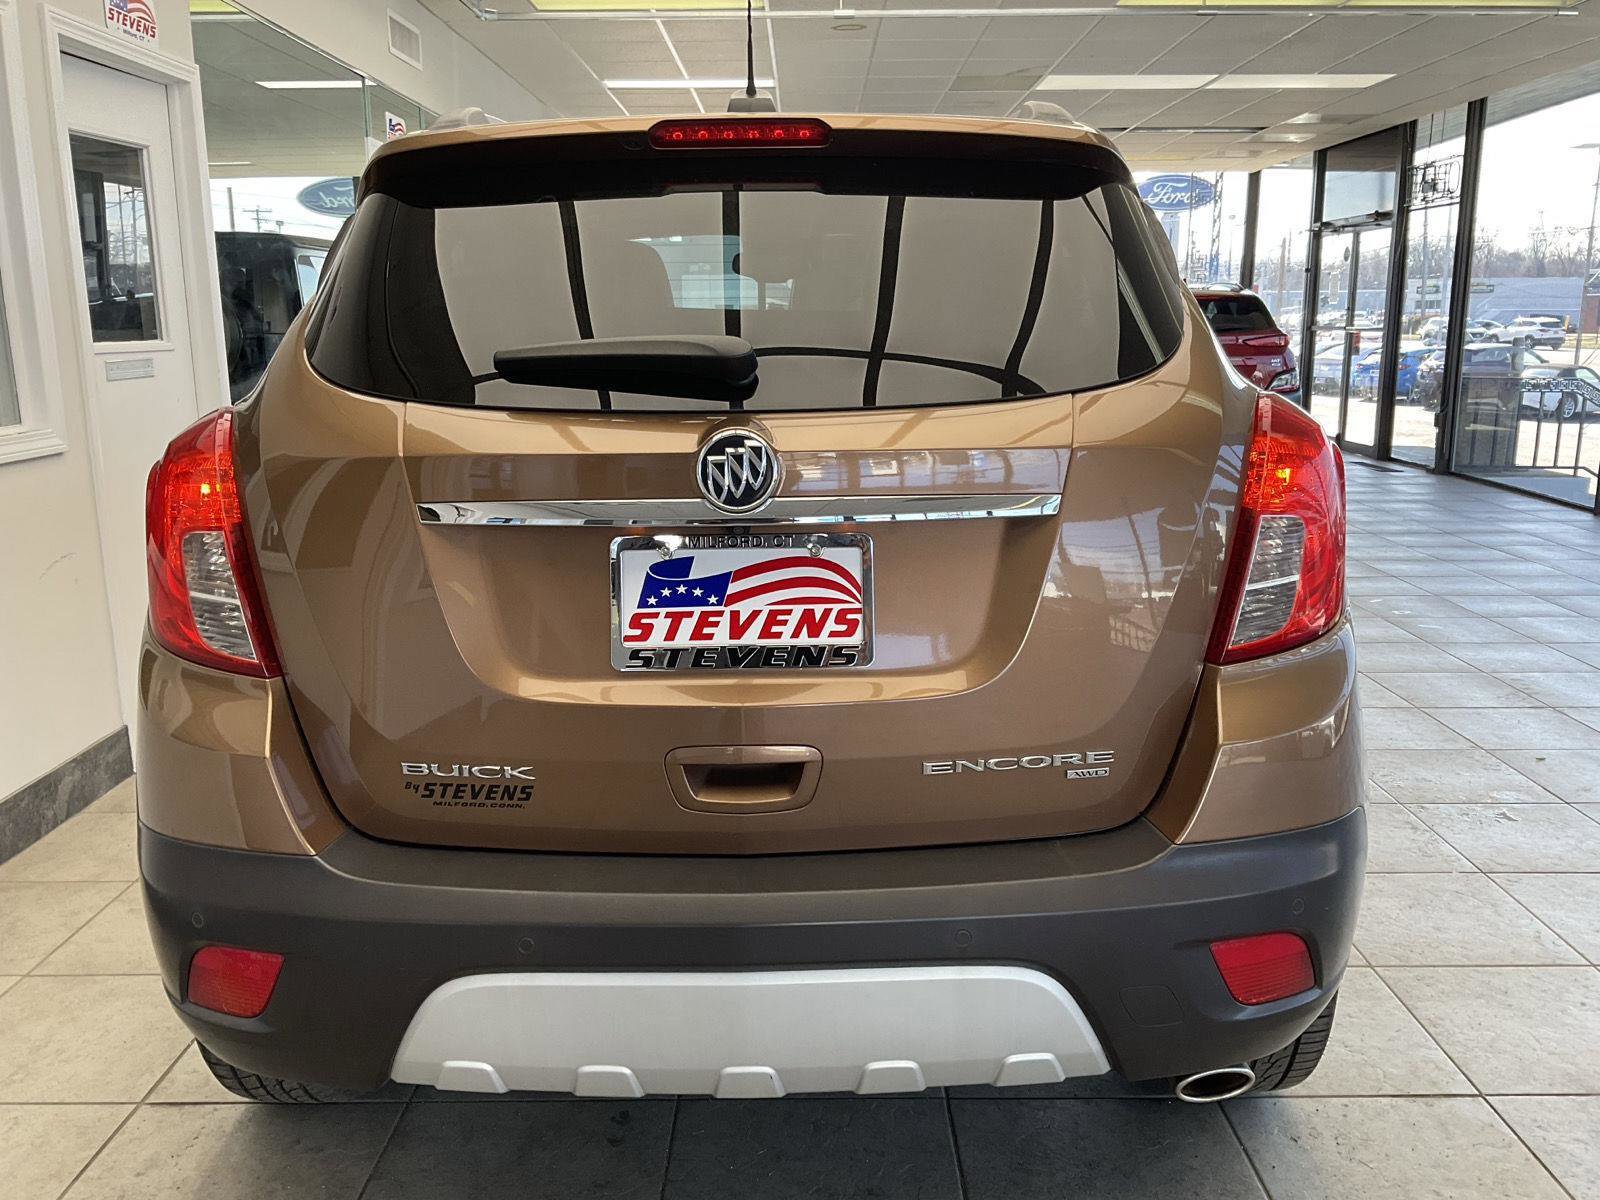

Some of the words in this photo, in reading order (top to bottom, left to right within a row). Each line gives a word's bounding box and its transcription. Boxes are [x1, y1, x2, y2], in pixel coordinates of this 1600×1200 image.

[108, 8, 156, 38] STEVENS
[773, 535, 795, 548] CT
[623, 607, 863, 643] STEVENS
[625, 645, 862, 669] STEVENS
[401, 762, 536, 780] BUICK
[922, 750, 1115, 775] ENCORE
[1067, 768, 1109, 779] AWD
[421, 782, 534, 801] STEVENS
